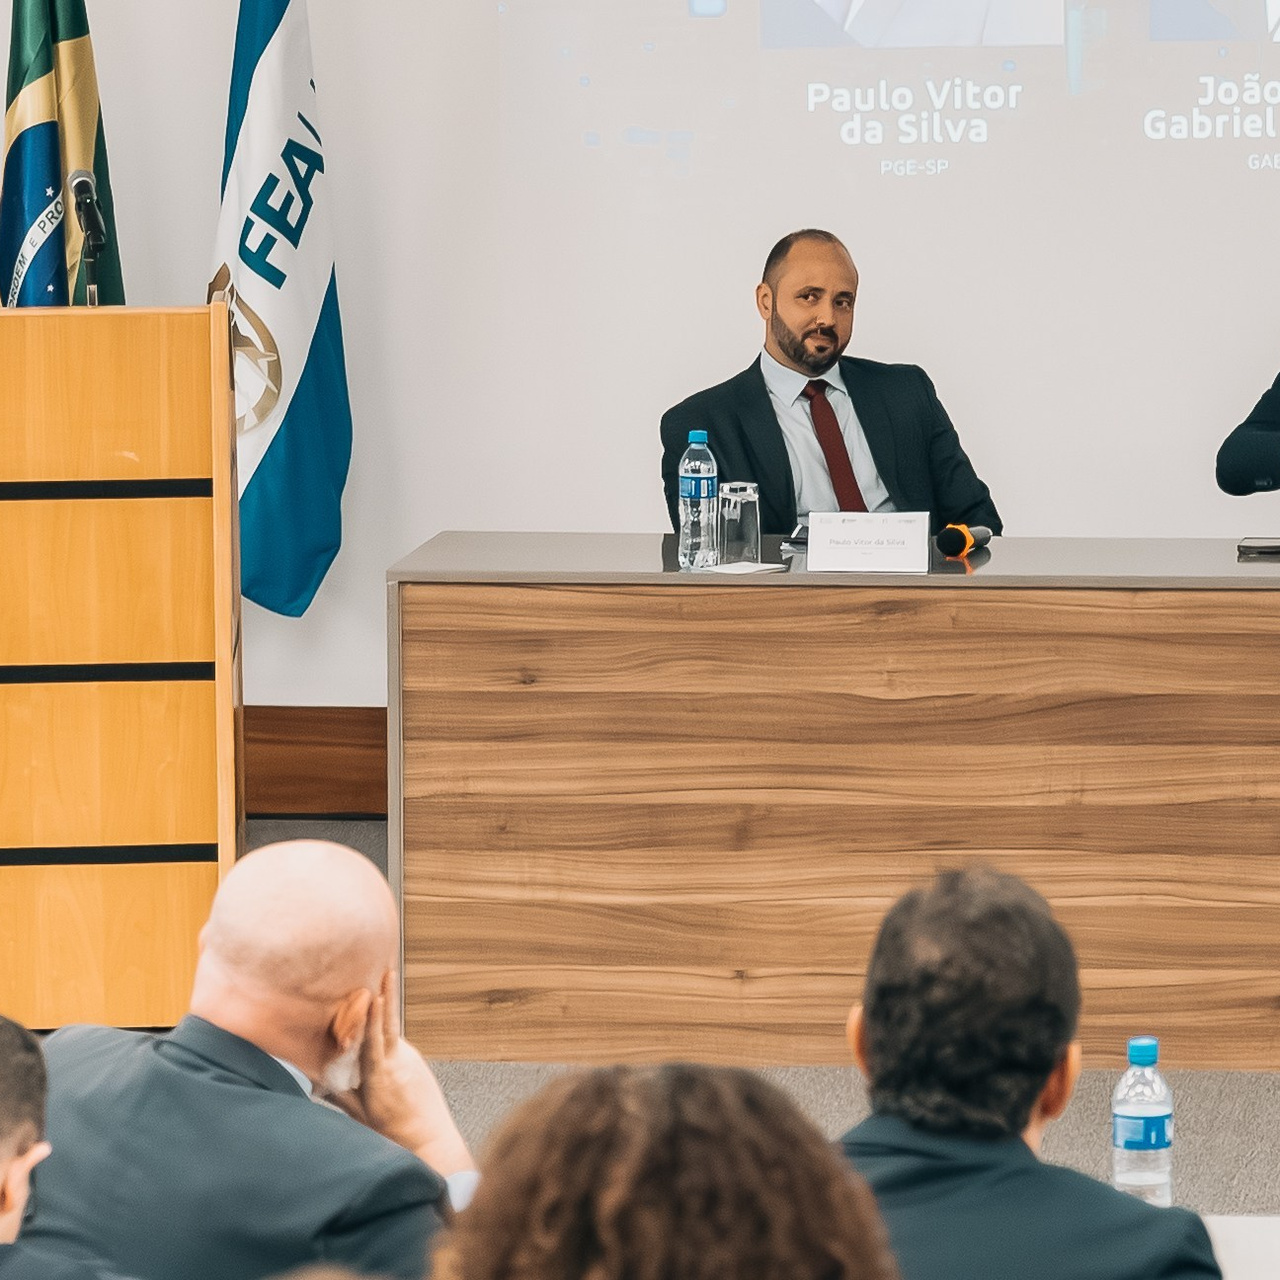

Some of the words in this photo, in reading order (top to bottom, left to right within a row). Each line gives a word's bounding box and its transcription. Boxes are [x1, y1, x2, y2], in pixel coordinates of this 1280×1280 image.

[807, 79, 914, 112] Paulo
[926, 77, 1023, 110] Vitor
[839, 112, 883, 145] da
[897, 110, 988, 144] Silva
[1143, 105, 1276, 140] Gabriel
[880, 158, 949, 176] PGE-SP
[238, 111, 325, 291] FEA
[29, 237, 38, 249] E
